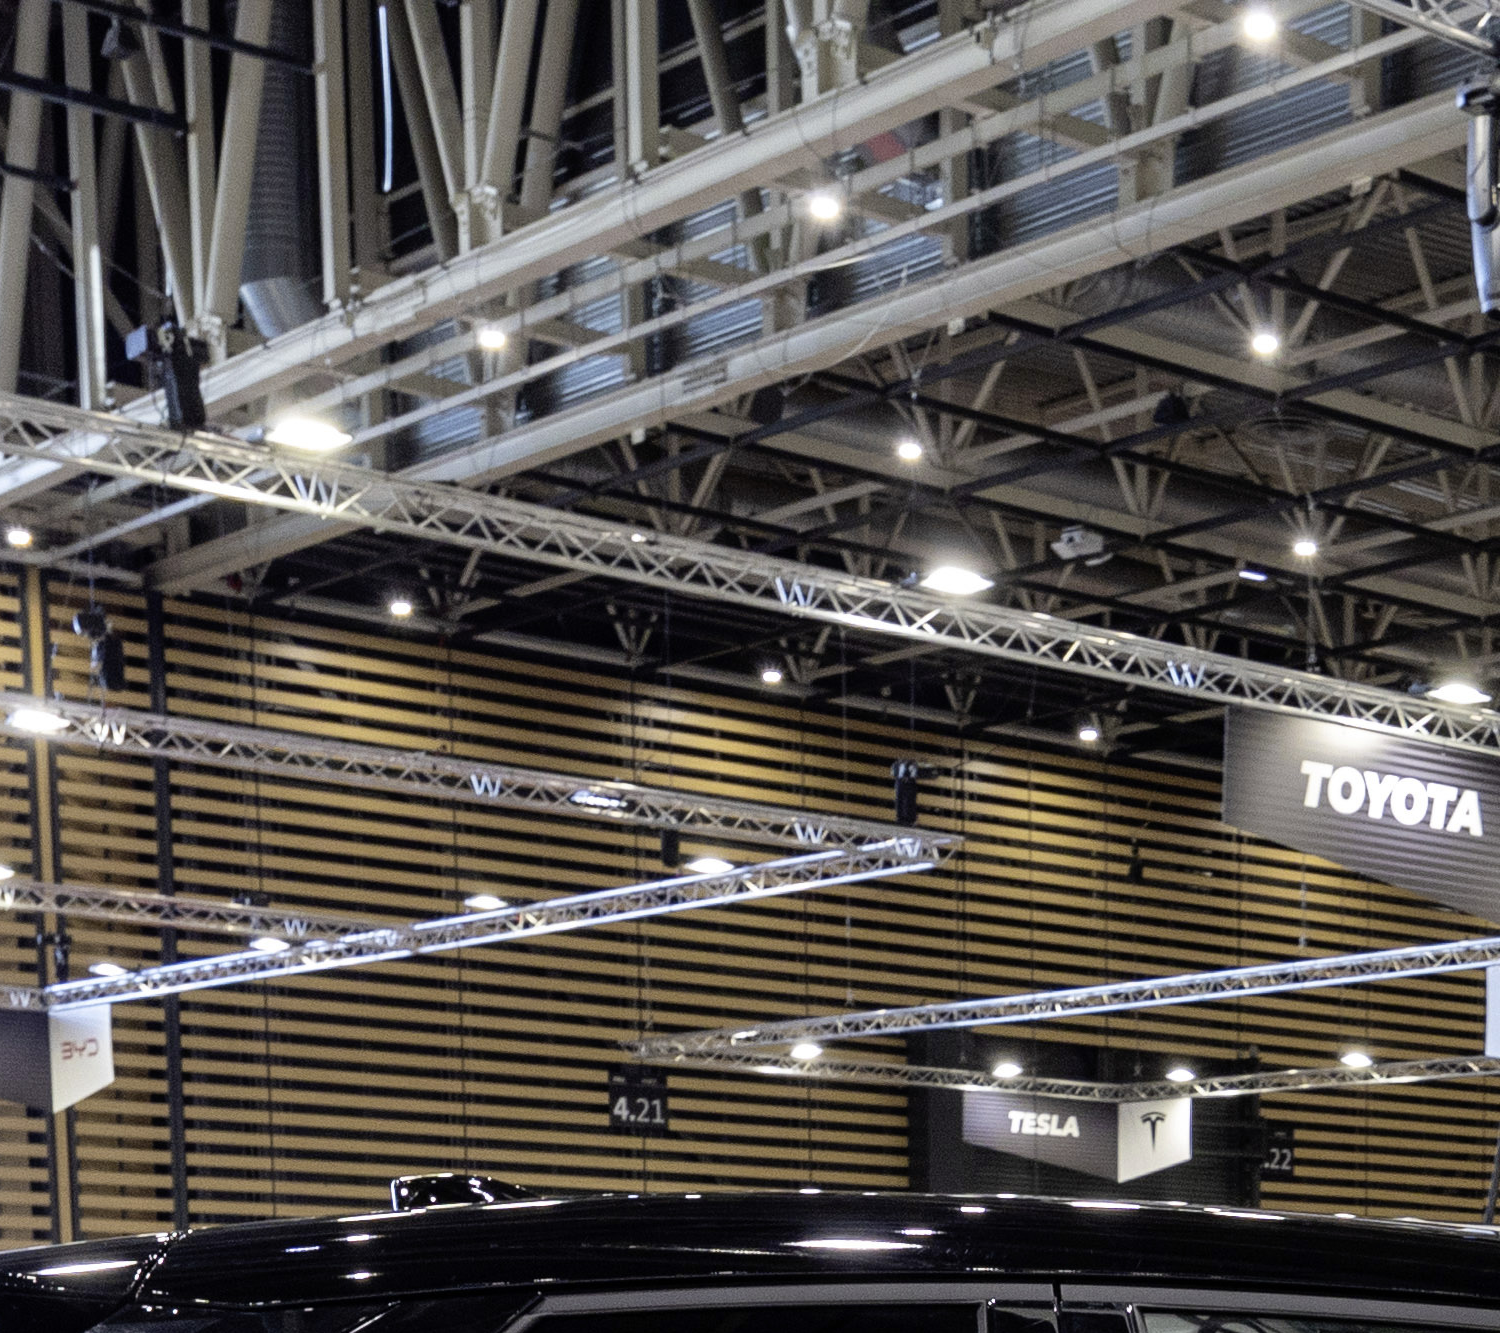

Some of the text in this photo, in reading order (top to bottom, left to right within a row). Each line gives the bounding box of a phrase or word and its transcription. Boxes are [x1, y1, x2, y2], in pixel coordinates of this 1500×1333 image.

[1300, 759, 1484, 837] TOYOTA
[60, 1037, 100, 1061] BYD
[612, 1096, 666, 1124] 4.21
[1007, 1109, 1081, 1139] TESLA
